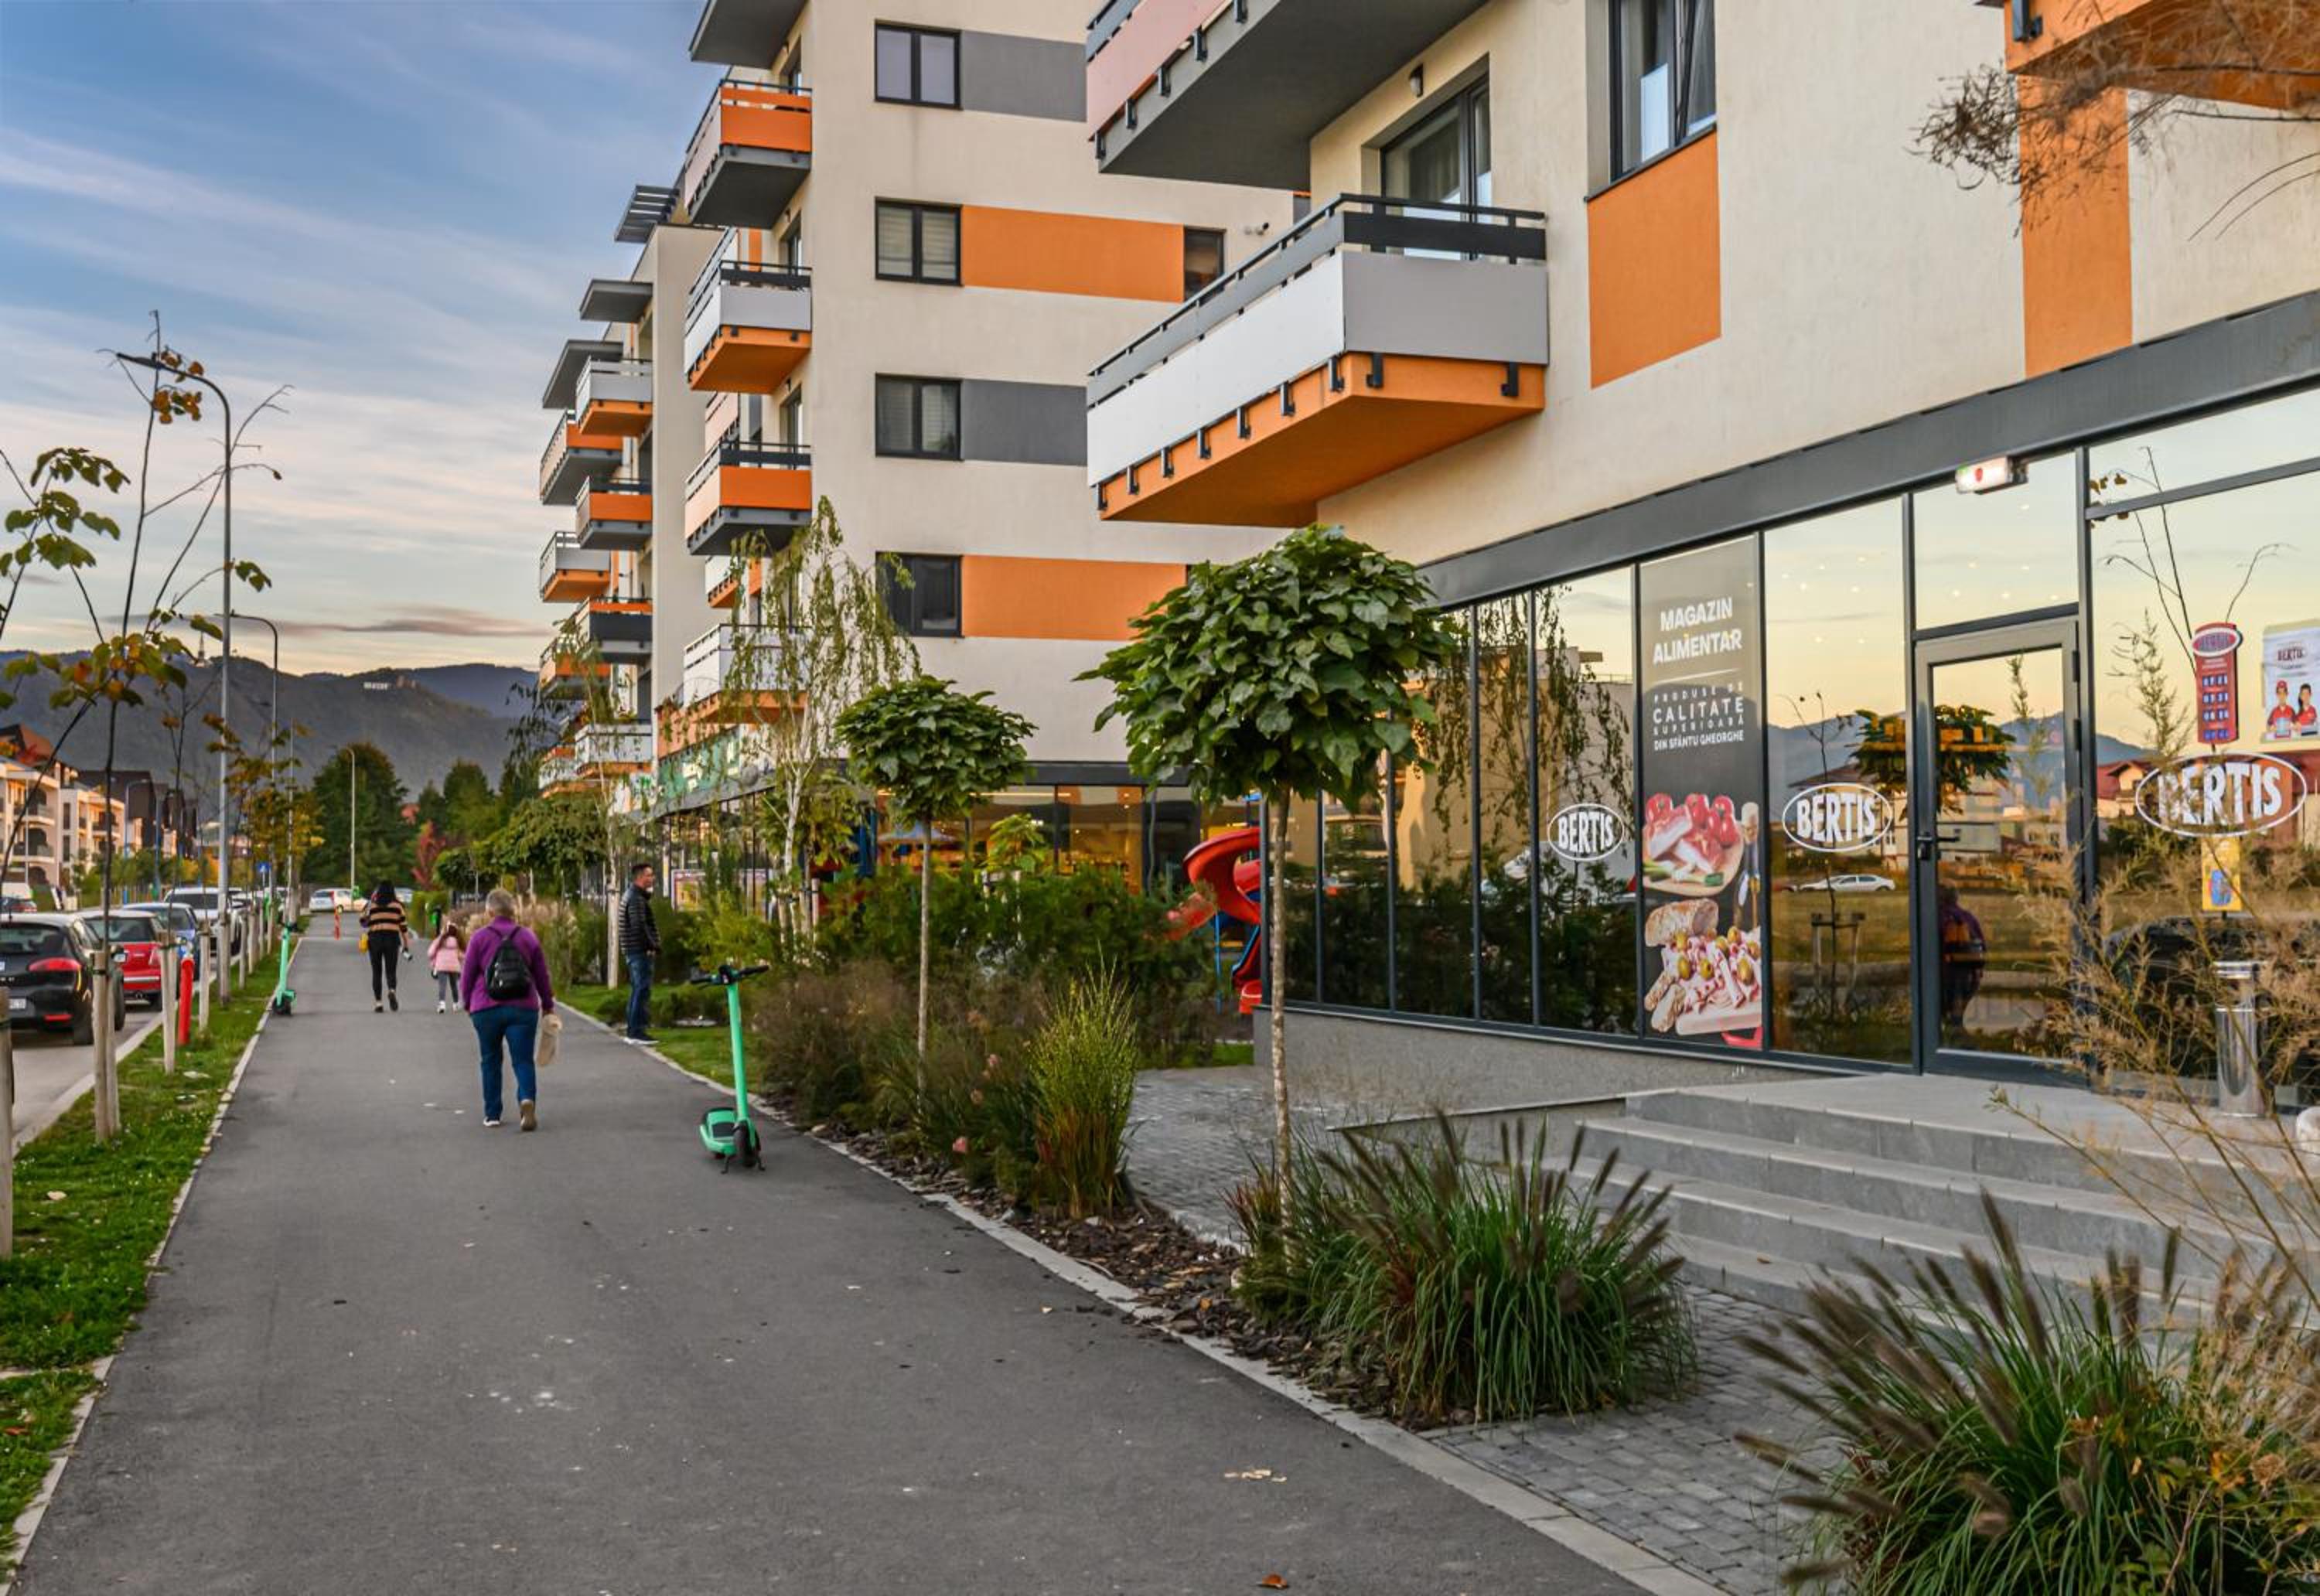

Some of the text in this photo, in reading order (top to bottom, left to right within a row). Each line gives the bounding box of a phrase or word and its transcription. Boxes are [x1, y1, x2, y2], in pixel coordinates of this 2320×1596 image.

[1660, 597, 1732, 631] MAGAZIN
[1653, 629, 1742, 665] ALIMENTAR
[1653, 696, 1744, 724] CALITATE
[2158, 762, 2282, 826] BERTIS
[1558, 811, 1613, 854] BERTIS
[1796, 791, 1875, 842] BERTIS
